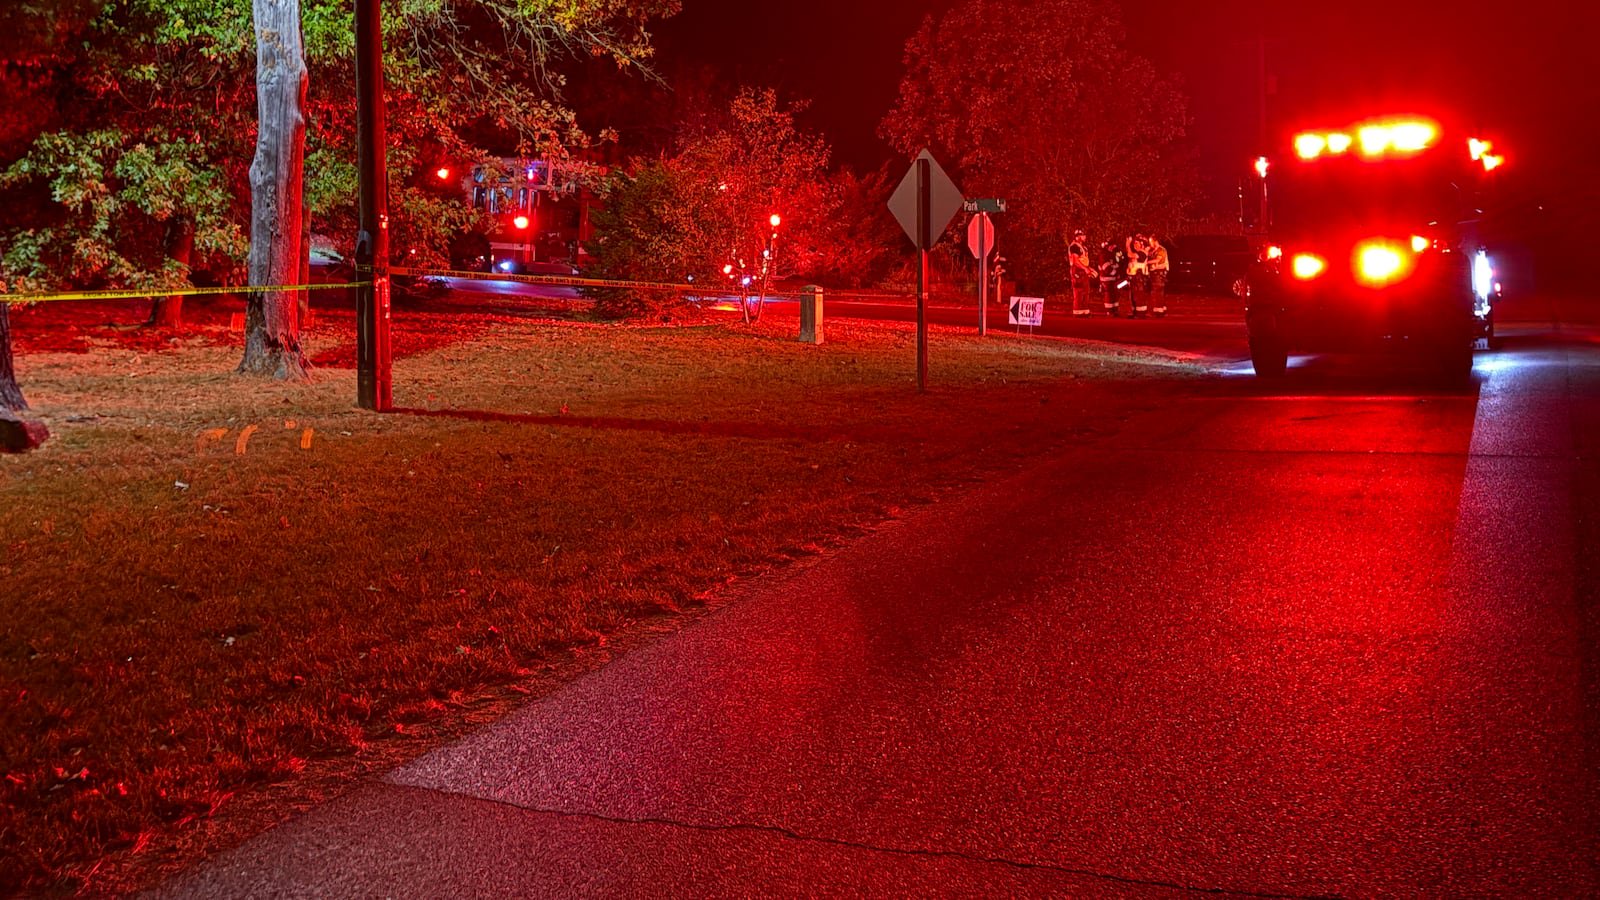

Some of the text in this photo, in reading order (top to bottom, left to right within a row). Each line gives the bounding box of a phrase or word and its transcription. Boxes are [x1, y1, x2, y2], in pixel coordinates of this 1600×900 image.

[963, 200, 978, 212] Park
[407, 268, 429, 276] CROSS
[1021, 302, 1037, 312] FOR
